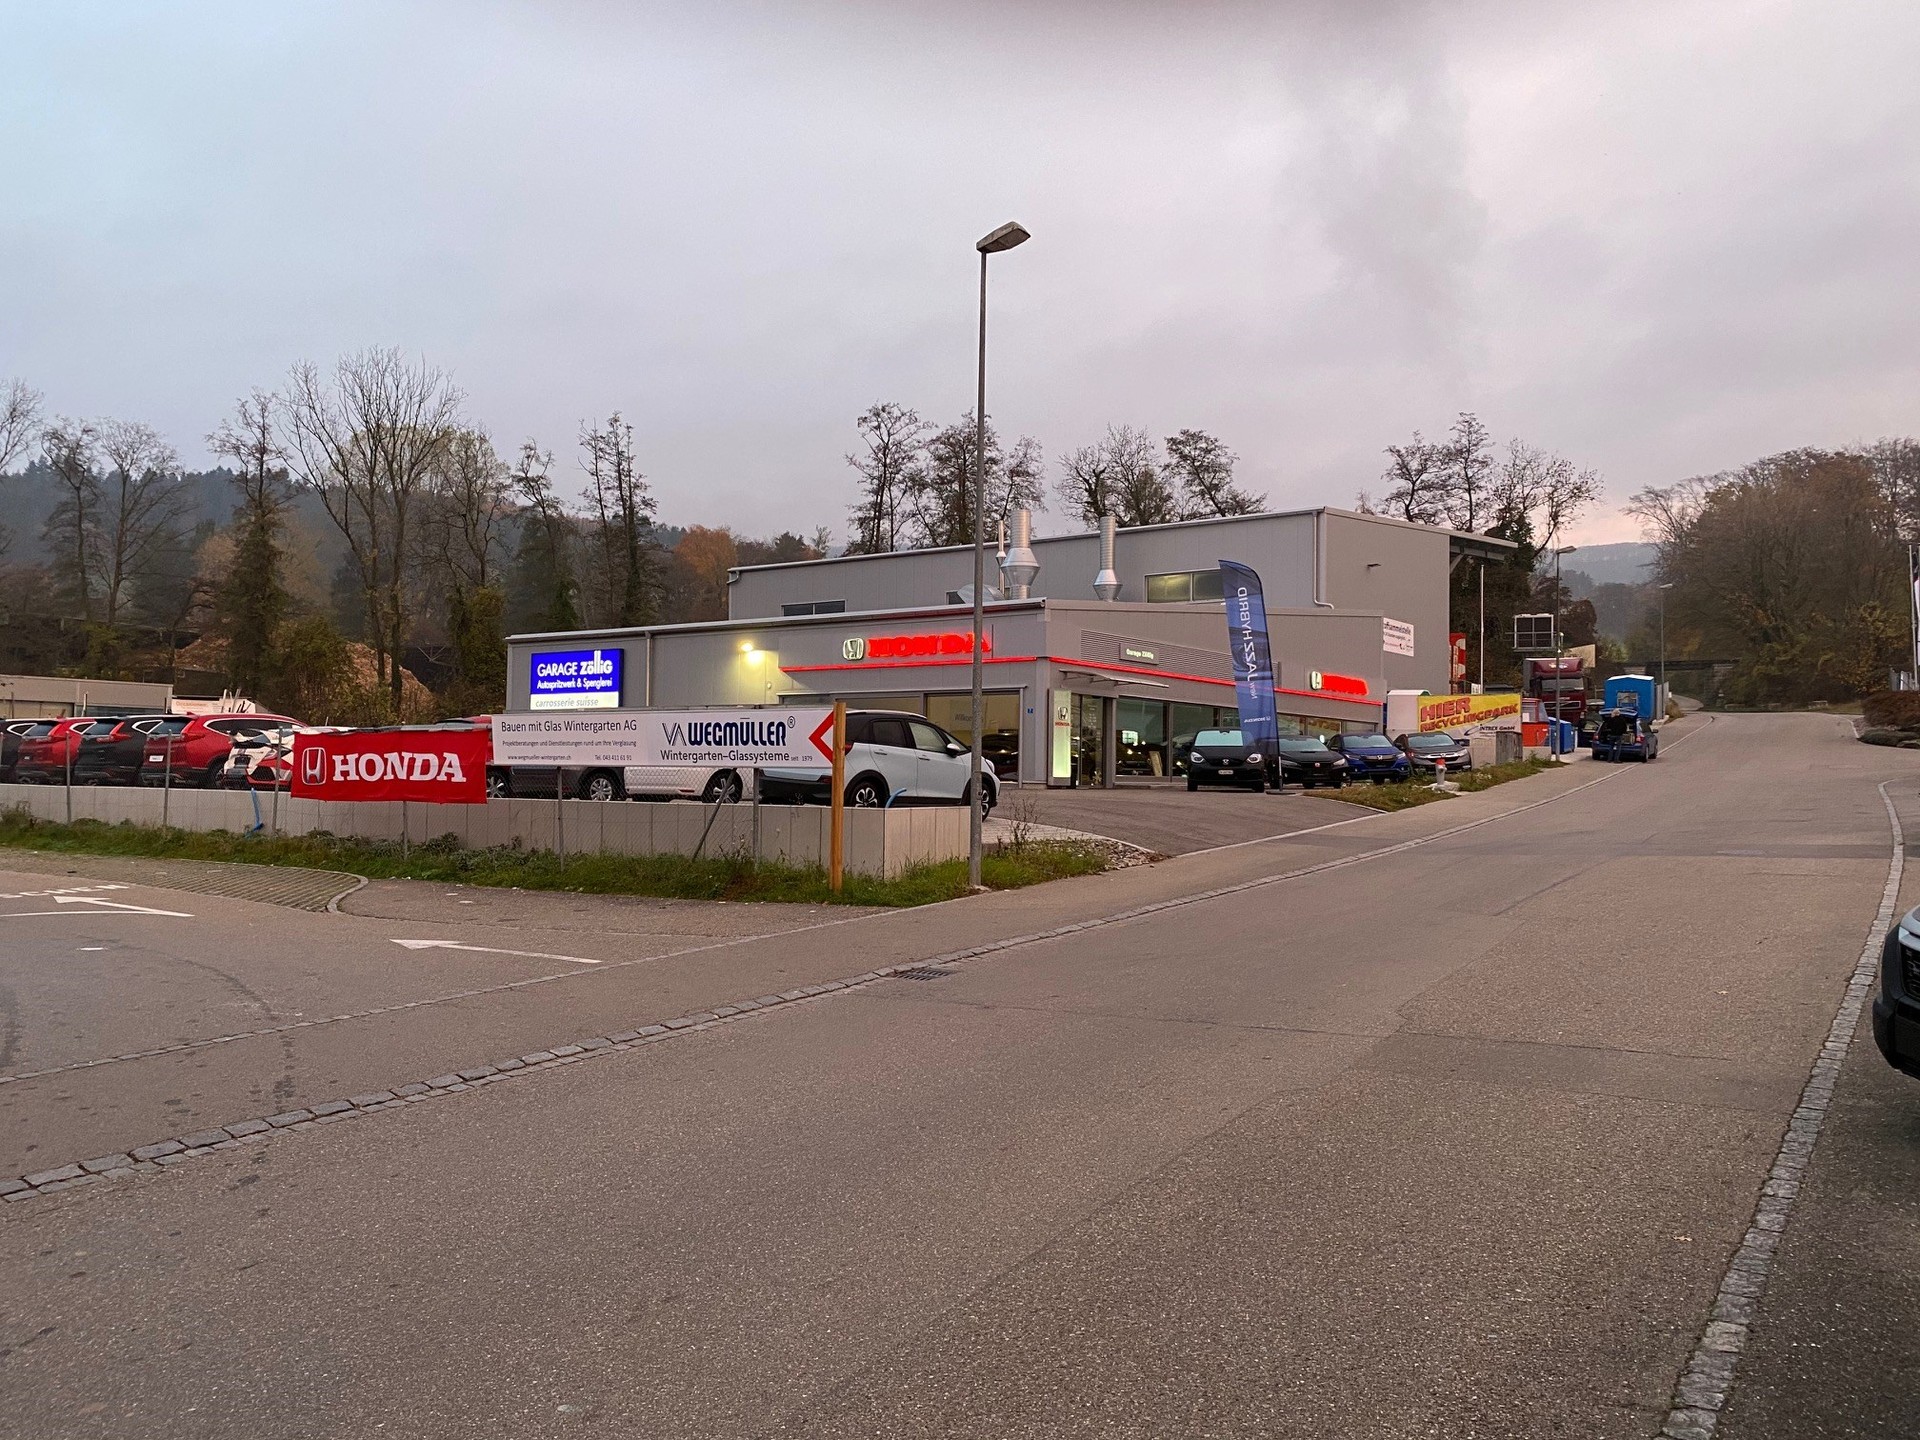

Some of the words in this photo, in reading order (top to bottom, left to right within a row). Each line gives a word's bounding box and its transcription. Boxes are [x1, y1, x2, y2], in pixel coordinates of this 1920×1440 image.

[537, 662, 578, 676] GARAGE
[537, 677, 576, 691] Autospritzwerk
[576, 677, 582, 688] &
[583, 676, 613, 690] Spenglerei
[535, 698, 574, 708] carrosserie
[576, 695, 599, 706] suisse
[1420, 697, 1471, 722] HIER
[1420, 703, 1519, 733] RECYCLINGPARK
[501, 721, 526, 732] Bauen
[529, 720, 542, 732] mit
[543, 720, 562, 732] Glas
[563, 720, 622, 734] Wintergarten
[623, 719, 637, 731] AG
[502, 739, 539, 747] Projektberatungen
[332, 751, 467, 783] HONDA
